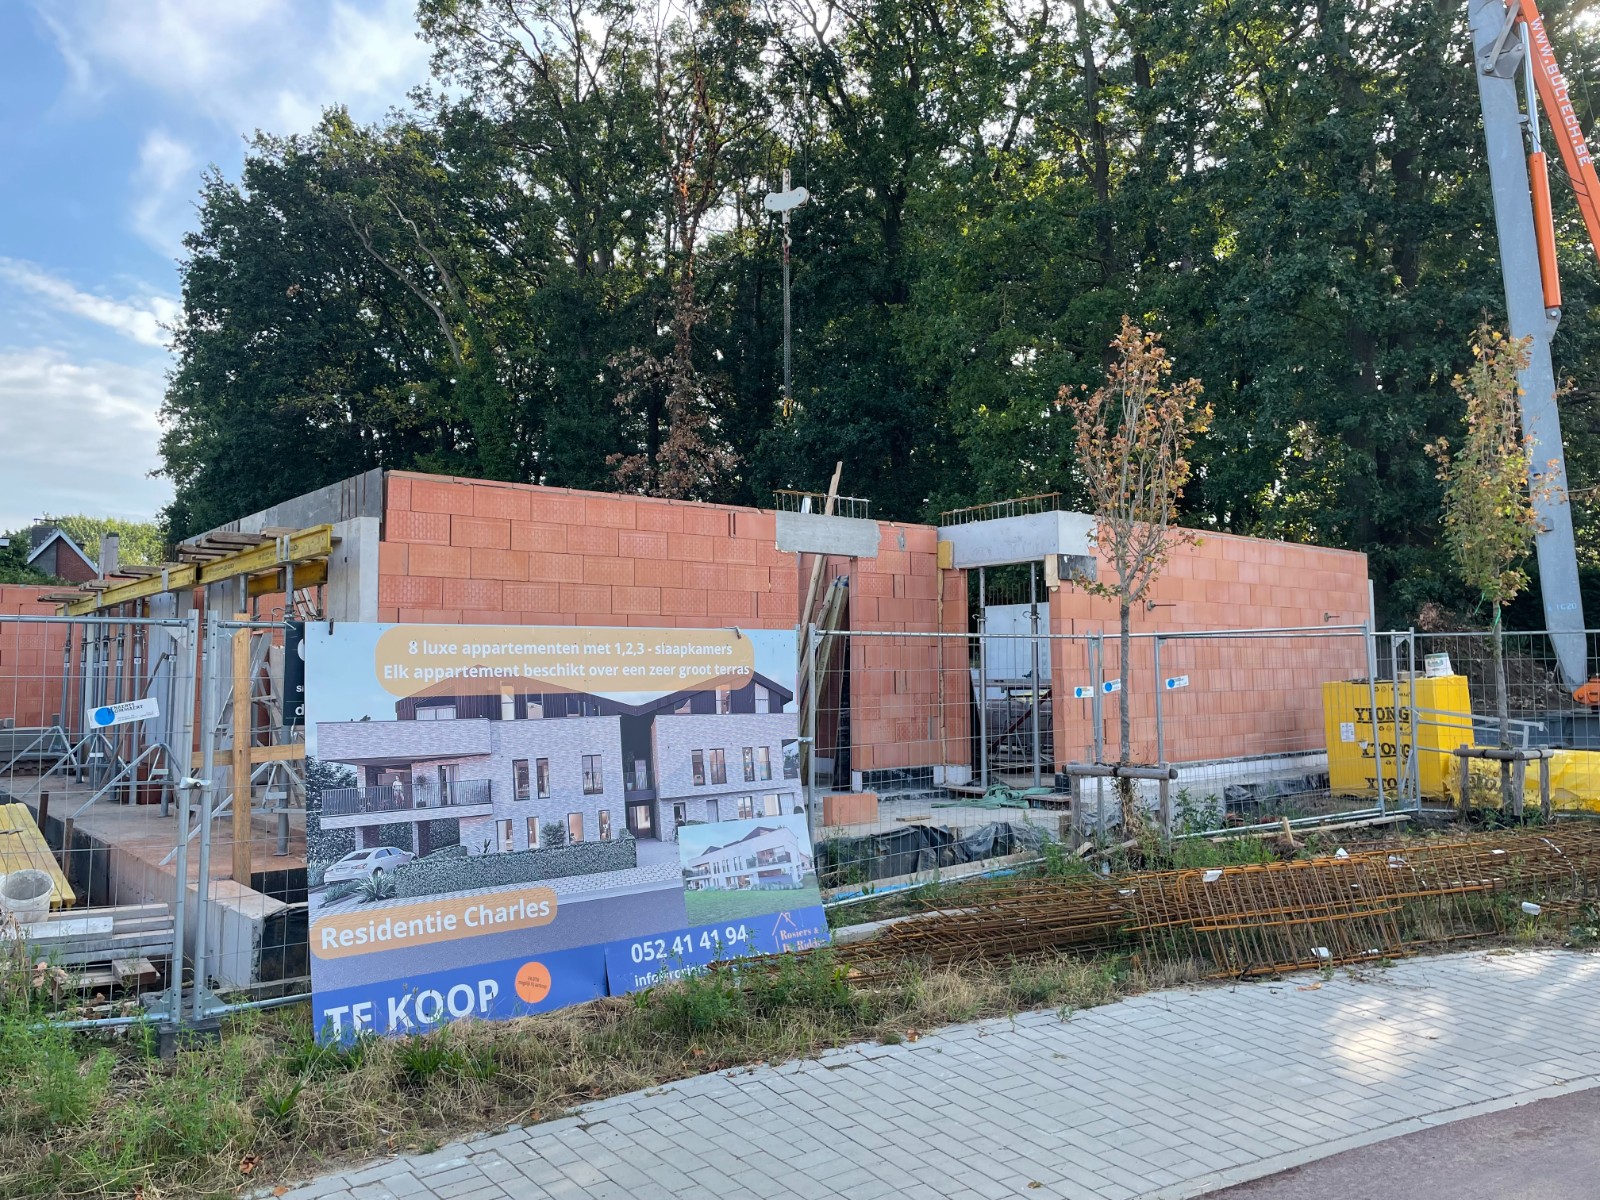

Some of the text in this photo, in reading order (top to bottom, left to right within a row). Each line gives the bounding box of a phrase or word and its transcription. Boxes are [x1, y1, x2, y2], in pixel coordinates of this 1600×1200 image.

[1531, 17, 1591, 167] WWW.BULTECH.BE
[408, 640, 418, 655] 8
[423, 640, 457, 655] luxe
[462, 642, 579, 659] appartementen
[583, 642, 611, 655] met
[614, 642, 645, 657] 1,2,3
[655, 642, 733, 658] slaapkamers
[384, 663, 750, 683] Elk appartement beschikt over een zeer groot terras
[321, 898, 550, 950] Residentie Charles
[631, 924, 748, 964] 052 41 41 94
[323, 979, 499, 1042] TE KOOP
